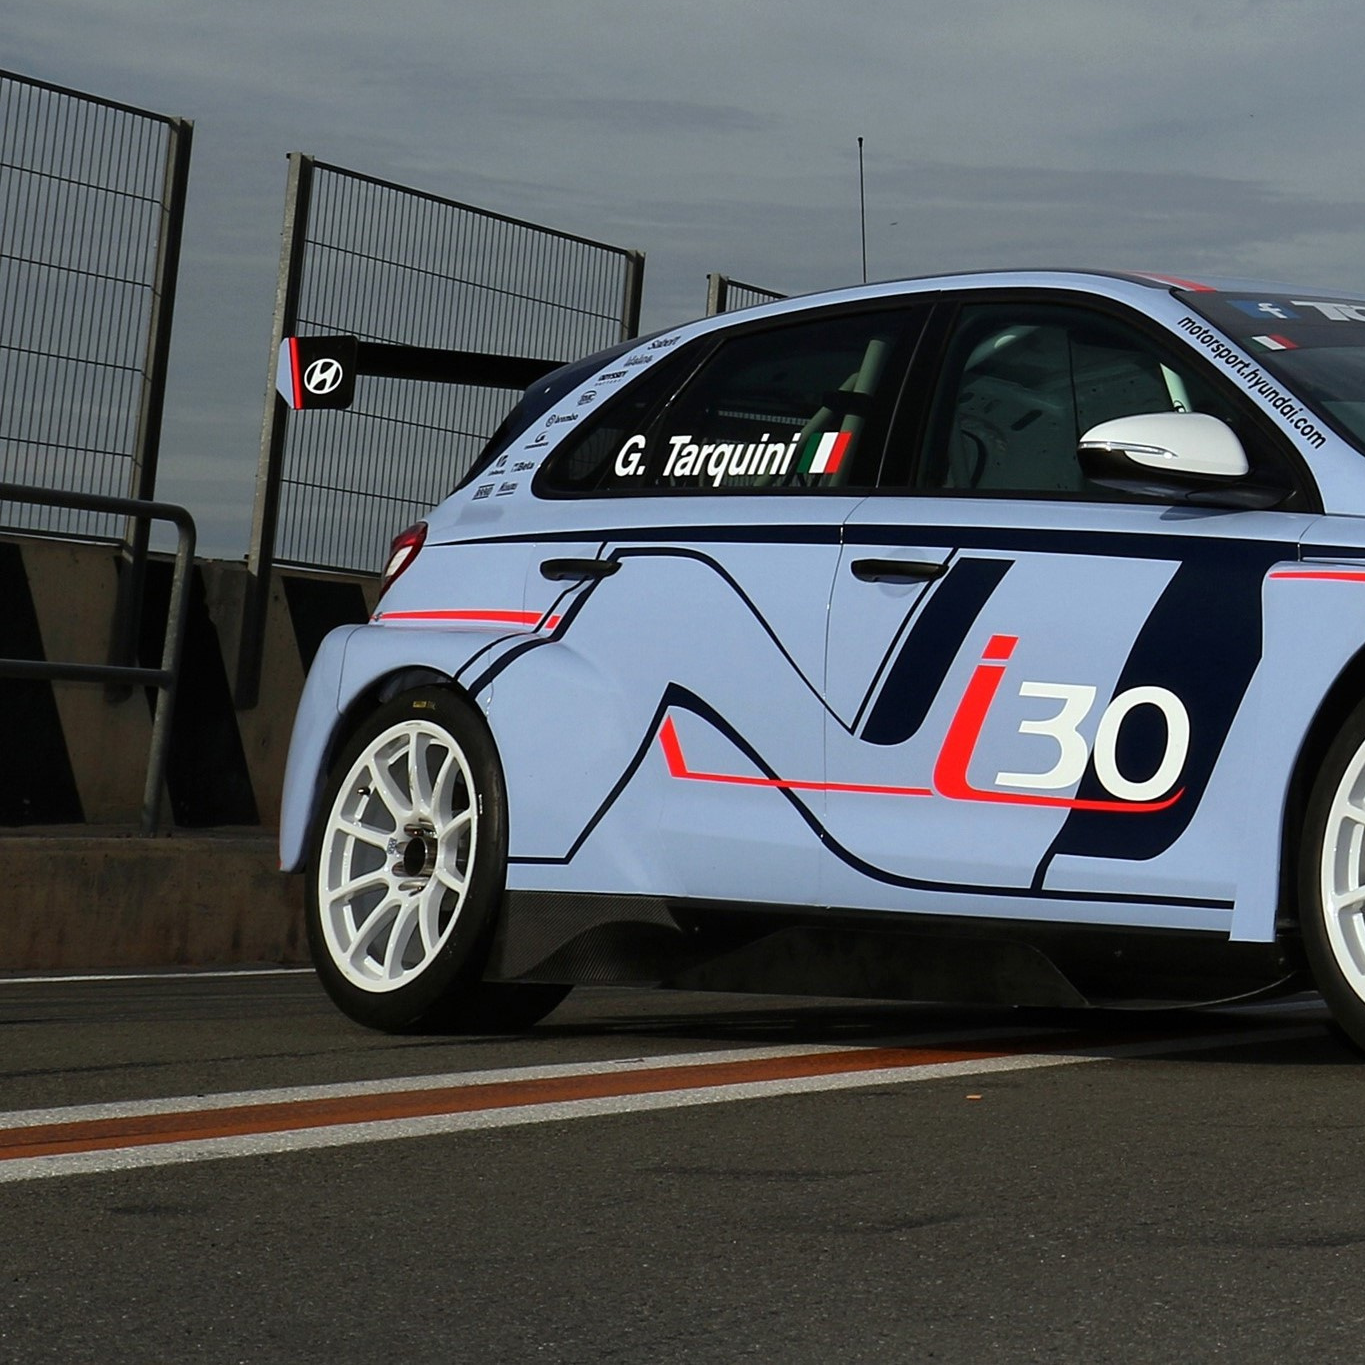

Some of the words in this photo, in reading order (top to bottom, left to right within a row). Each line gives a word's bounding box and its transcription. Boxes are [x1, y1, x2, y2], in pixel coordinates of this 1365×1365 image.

[1177, 316, 1327, 450] motorsport.hyundai.com
[615, 434, 647, 477] G.
[662, 433, 802, 488] Tarquini
[934, 634, 1191, 809] i30
